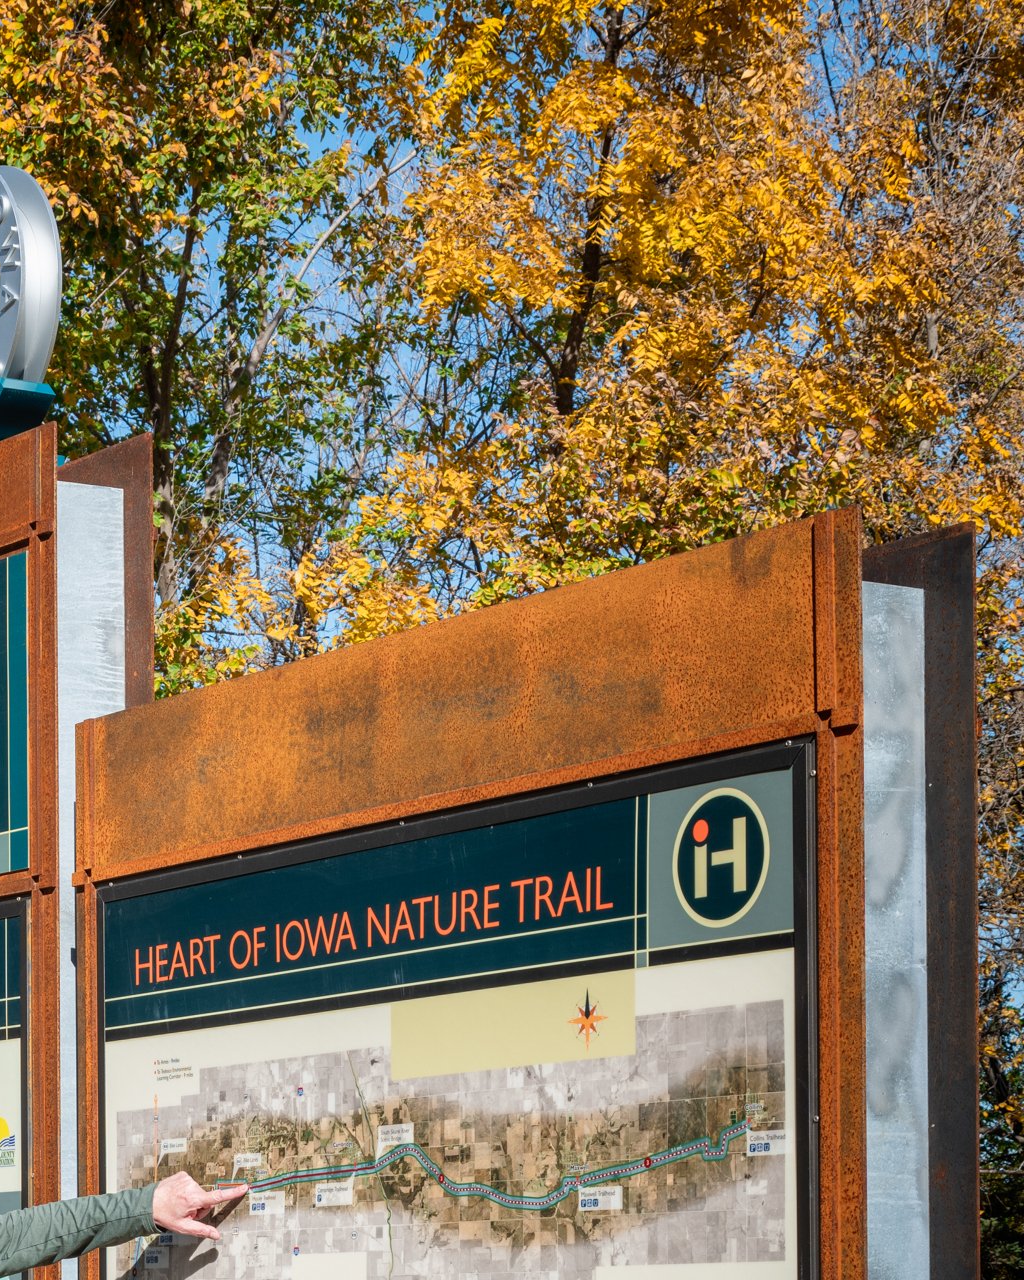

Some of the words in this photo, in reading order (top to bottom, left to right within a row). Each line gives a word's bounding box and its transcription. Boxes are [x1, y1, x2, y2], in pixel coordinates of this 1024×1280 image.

[135, 934, 221, 986] HEART
[229, 926, 266, 970] OF
[275, 911, 357, 963] IOWA
[367, 884, 500, 948] NATURE
[510, 866, 614, 923] TRAIL
